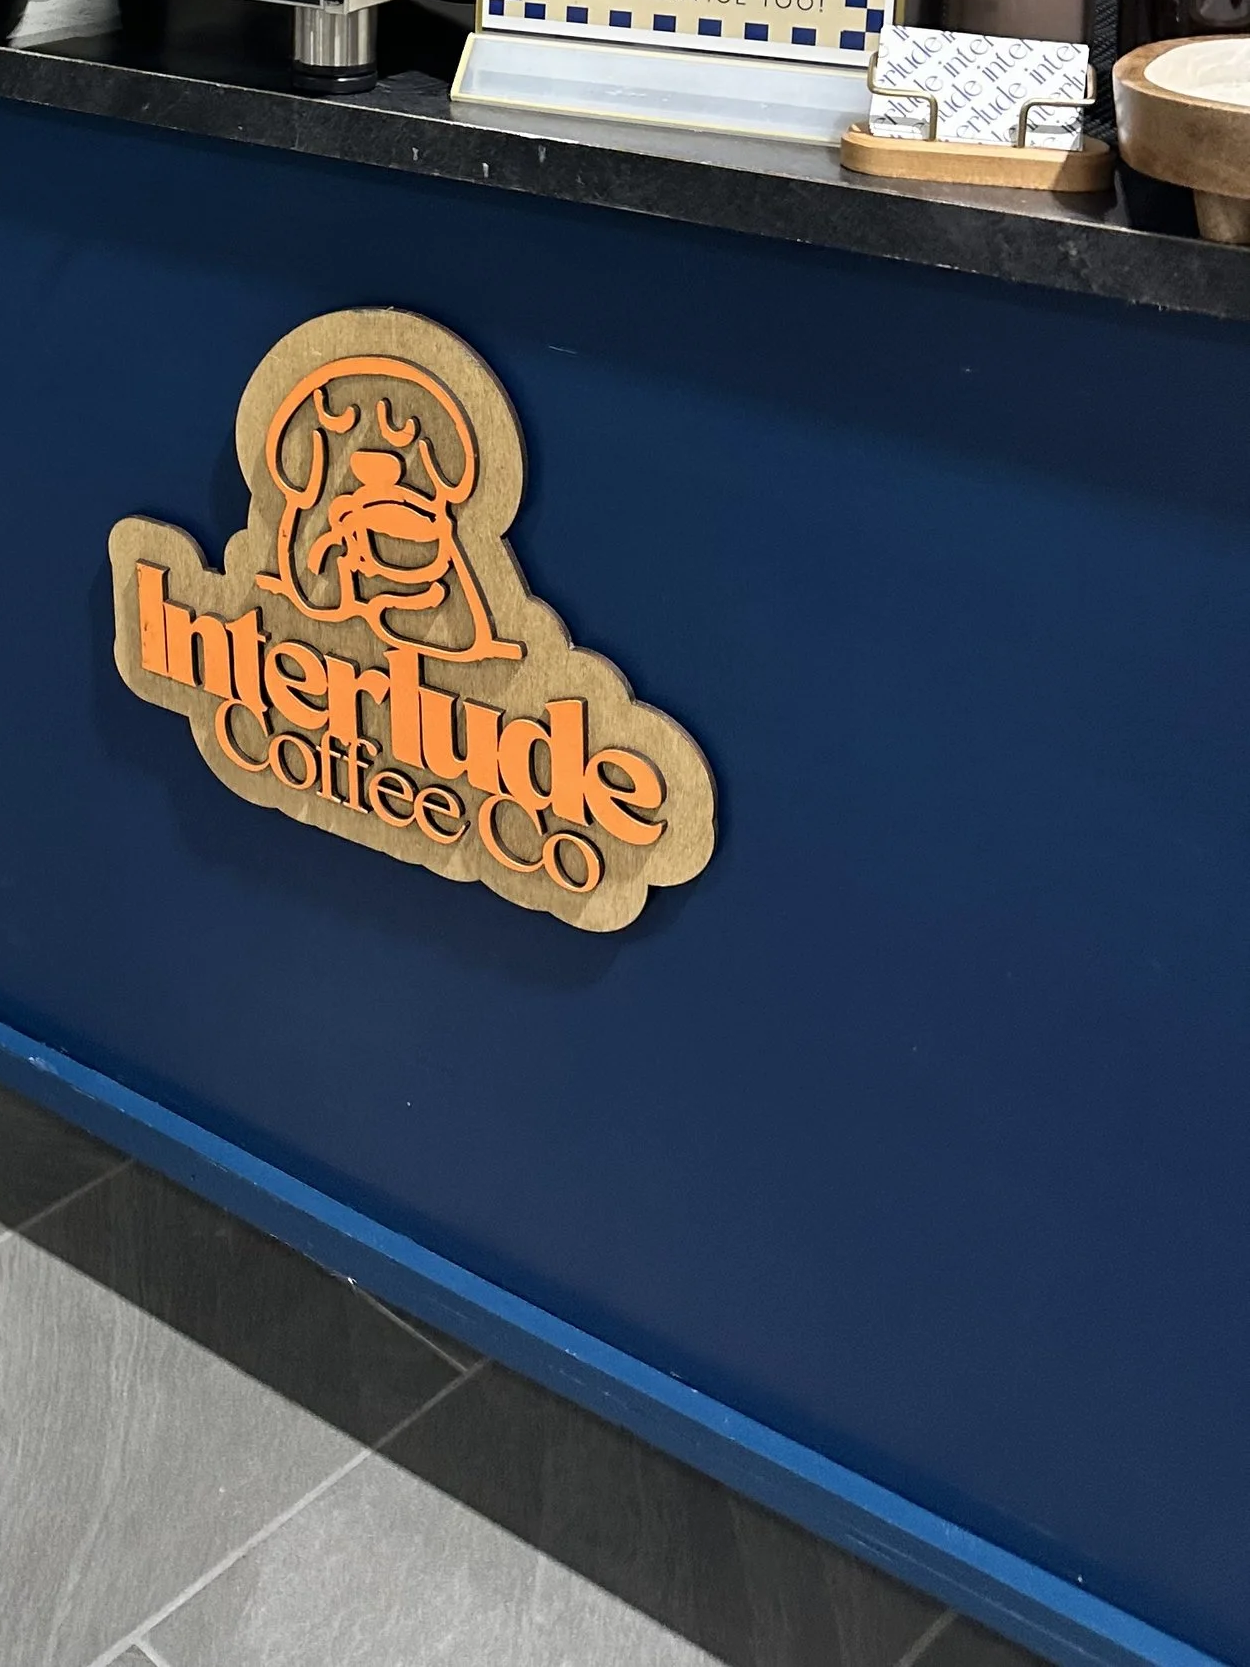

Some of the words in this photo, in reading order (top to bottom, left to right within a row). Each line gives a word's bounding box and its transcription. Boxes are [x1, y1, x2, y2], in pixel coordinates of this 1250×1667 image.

[136, 556, 668, 847] Interlude
[214, 698, 470, 845] Coffee
[478, 793, 606, 894] Co
